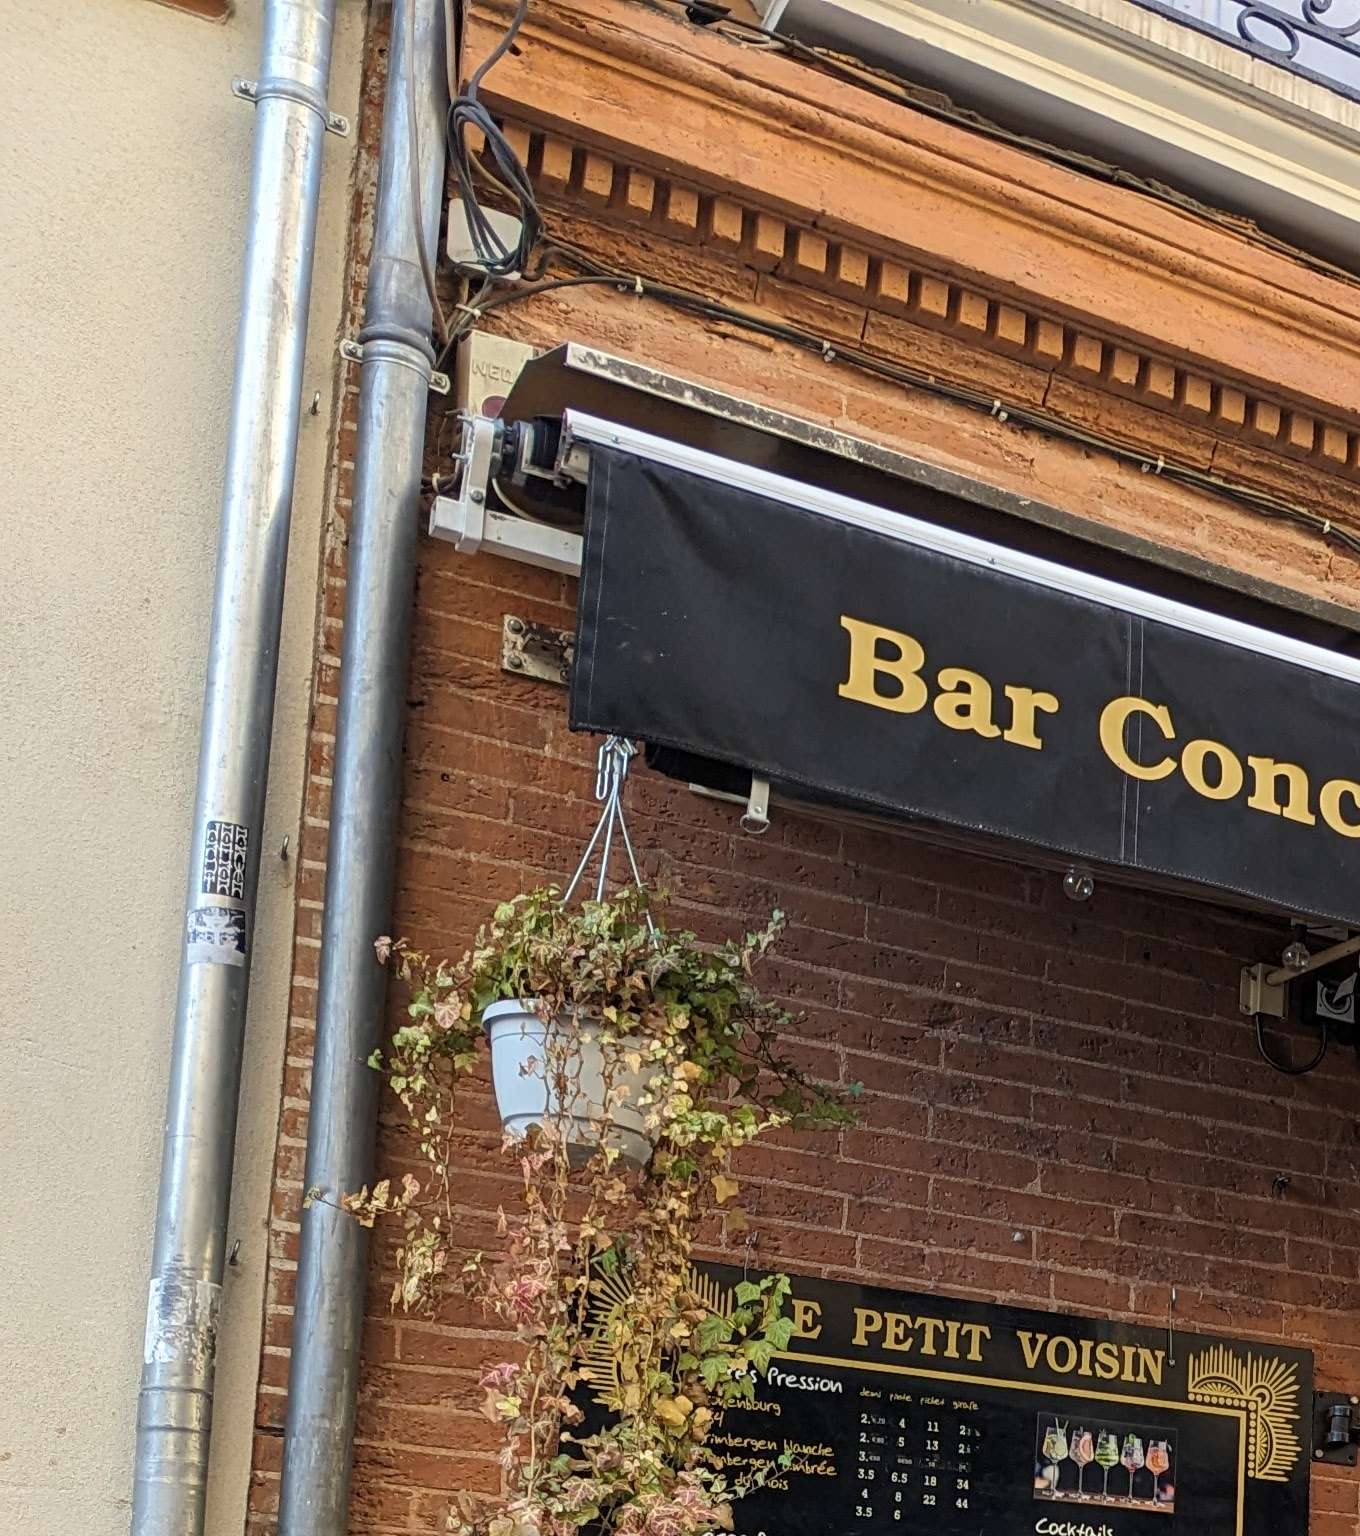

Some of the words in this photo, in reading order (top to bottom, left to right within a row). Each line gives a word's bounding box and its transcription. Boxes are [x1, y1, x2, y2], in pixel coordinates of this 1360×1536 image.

[838, 615, 1059, 750] Bar
[851, 1307, 992, 1362] PETIT
[1019, 1330, 1166, 1389] VOISIN
[767, 1366, 843, 1394] Pression
[898, 1417, 906, 1429] 4
[927, 1420, 939, 1433] 11
[784, 1439, 834, 1456] blanche
[898, 1436, 905, 1448] 5
[926, 1439, 939, 1451] 13
[857, 1468, 875, 1480] 3.5
[891, 1471, 908, 1484] 6.5
[923, 1475, 937, 1487] 18
[956, 1478, 969, 1490] 34
[861, 1488, 869, 1499] 4
[894, 1491, 902, 1503] 8
[922, 1494, 936, 1506] 22
[955, 1498, 969, 1509] 44
[855, 1505, 873, 1518] 3.5
[893, 1509, 901, 1521] 6
